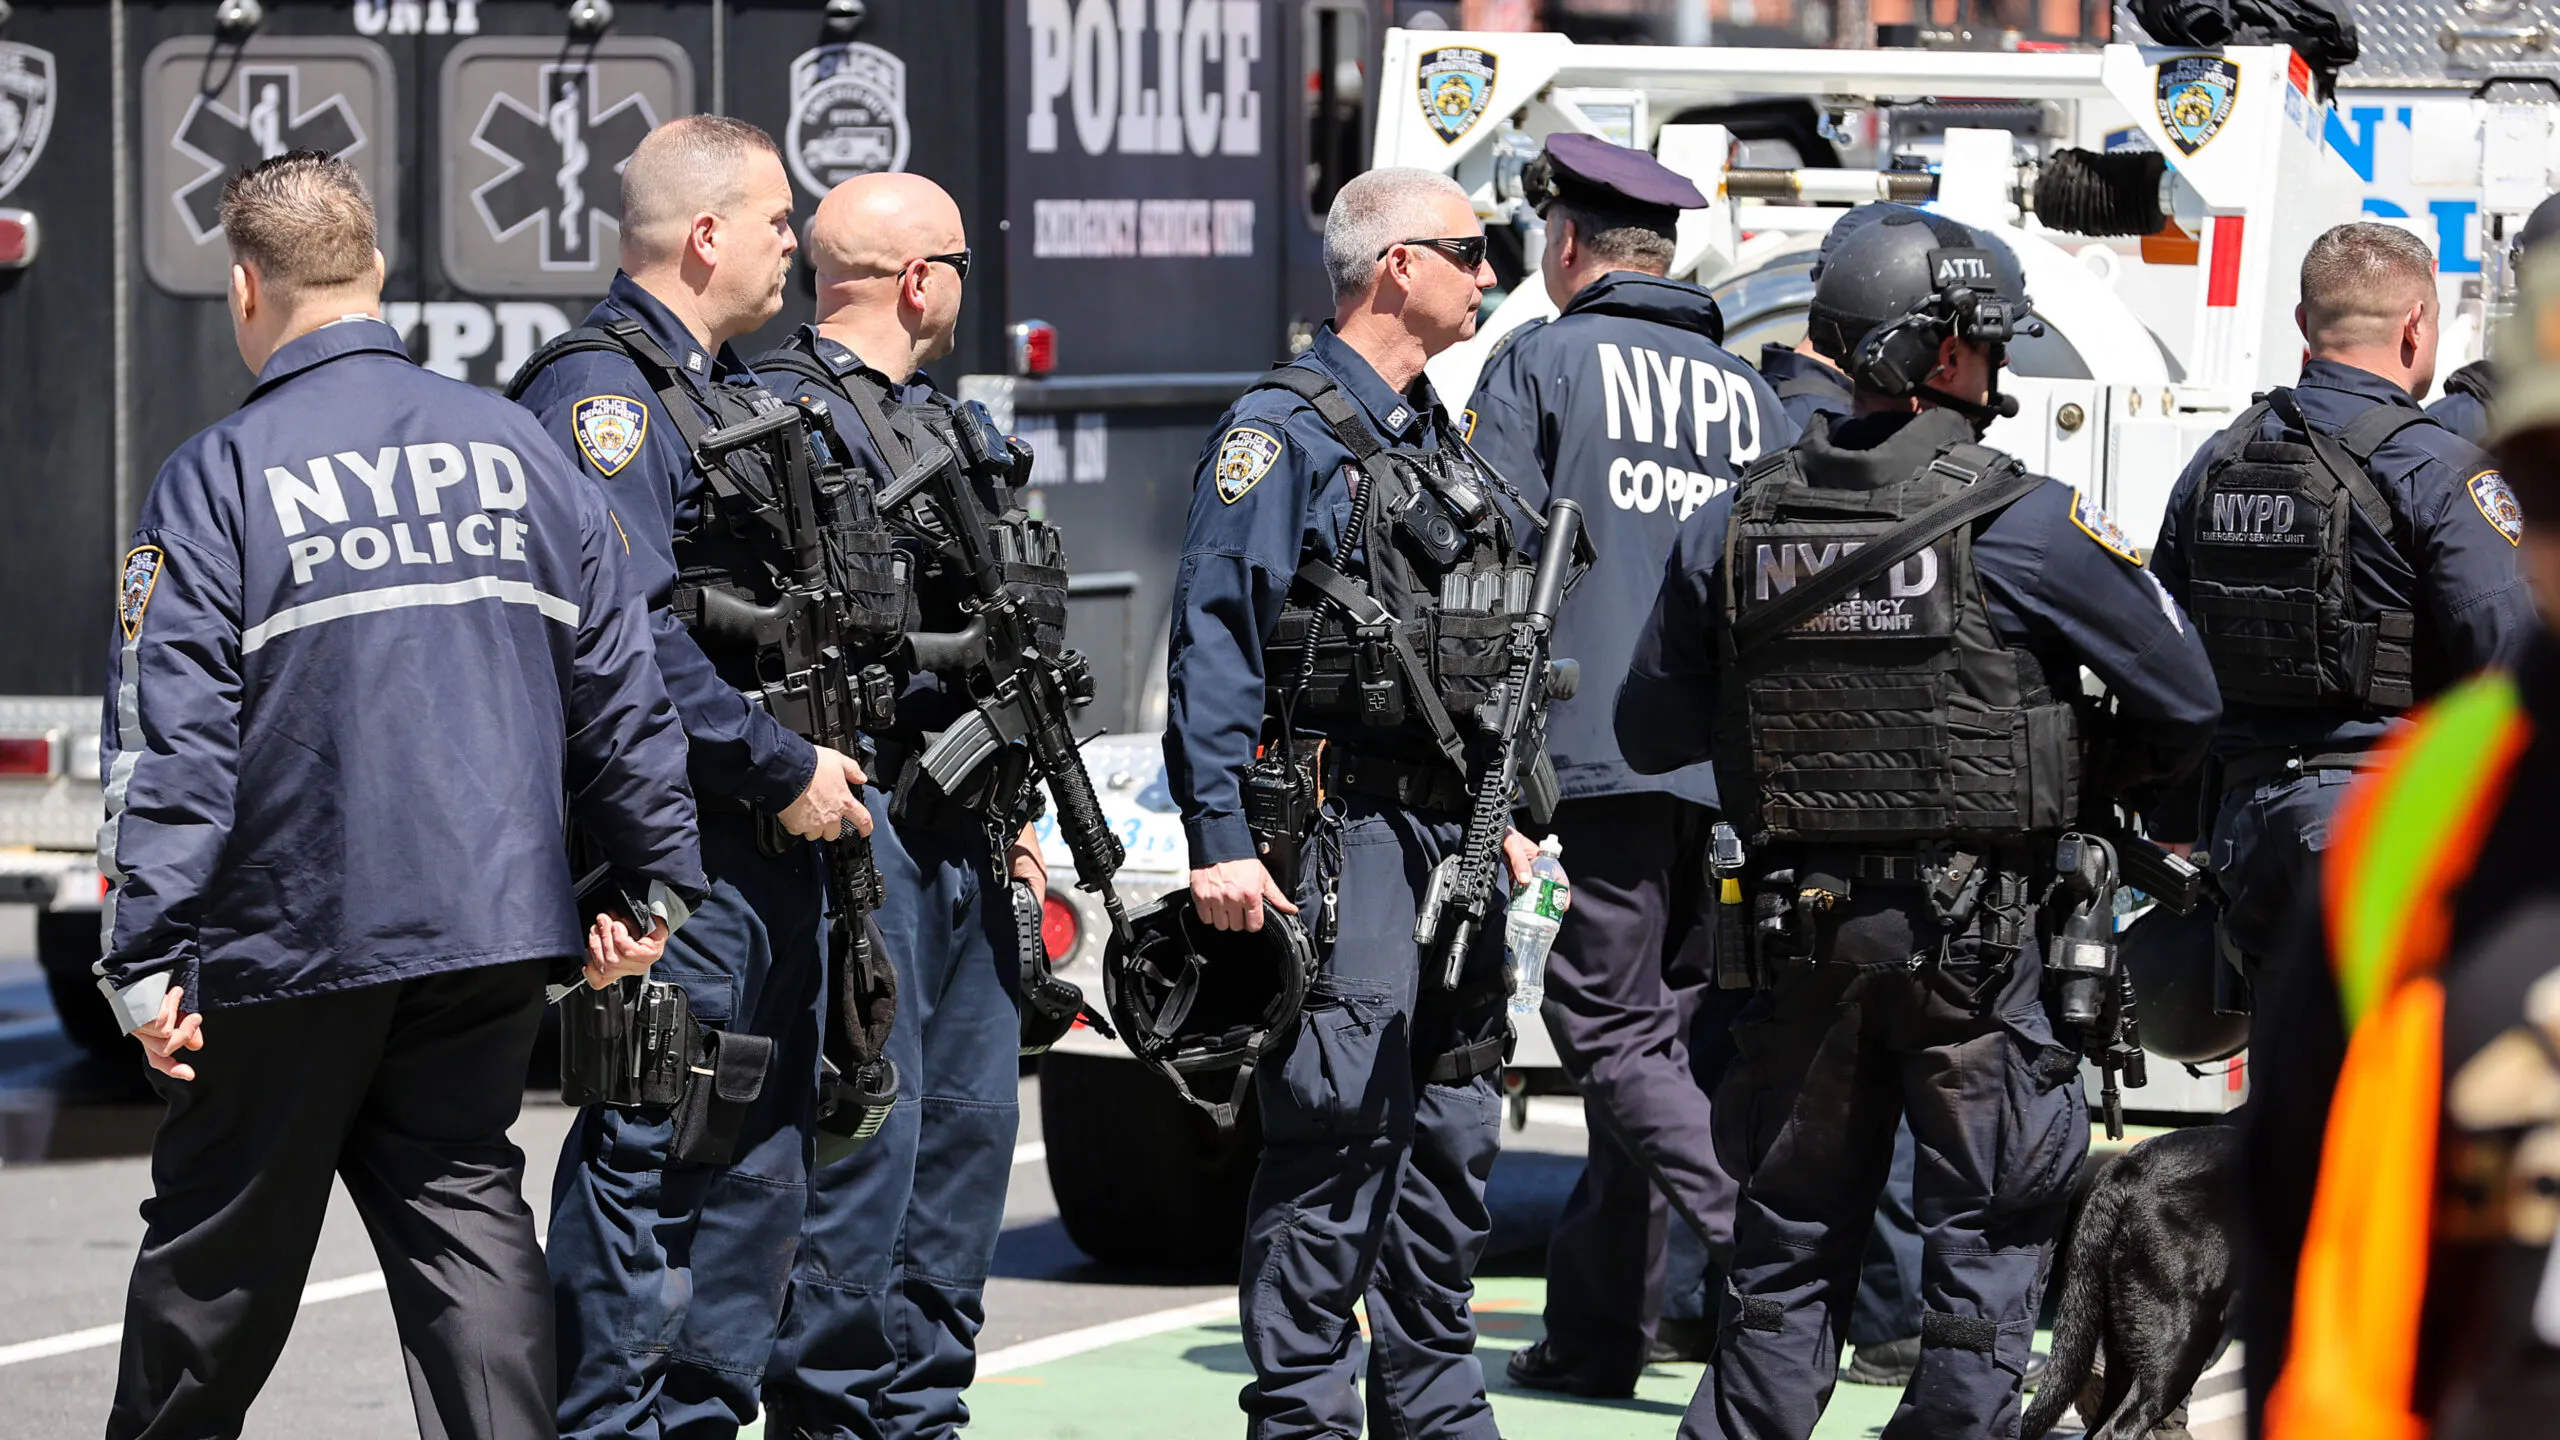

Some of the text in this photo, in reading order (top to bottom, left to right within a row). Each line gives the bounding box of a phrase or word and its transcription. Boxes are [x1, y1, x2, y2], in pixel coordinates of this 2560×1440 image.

[1436, 48, 1483, 64] POLICE
[2177, 58, 2225, 74] POLICE
[1027, 0, 1261, 157] POLICE
[579, 406, 640, 423] DEPARTMENT
[592, 399, 628, 410] POLICE
[1597, 343, 1761, 466] NYPD
[1386, 406, 1409, 429] ESU
[579, 429, 602, 460] CITY OF
[627, 428, 642, 449] YORK
[1237, 432, 1269, 448] POLICE
[1224, 439, 1274, 461] DEPARTMENT
[264, 443, 528, 538] NYPD
[2213, 493, 2295, 534] NYPD
[288, 513, 528, 585] POLICE
[2202, 531, 2305, 545] EMERGENCY SERVICE UNIT
[1756, 542, 1938, 601] NYD
[1867, 614, 1914, 632] UNIT
